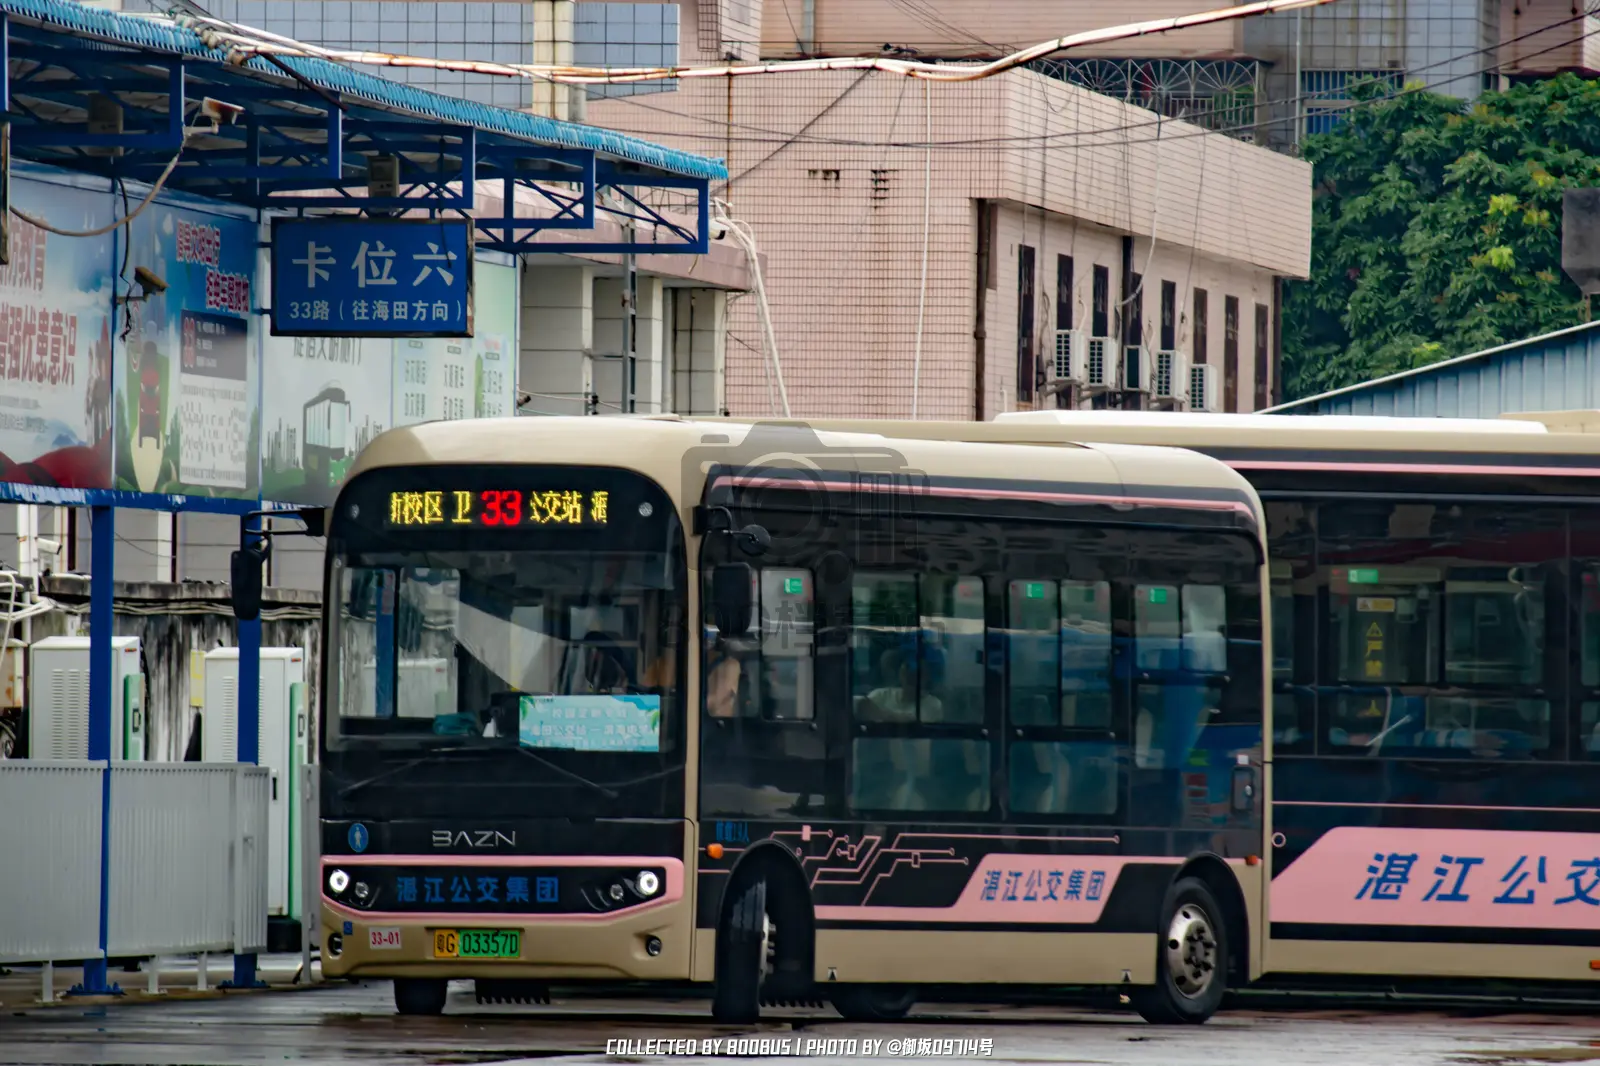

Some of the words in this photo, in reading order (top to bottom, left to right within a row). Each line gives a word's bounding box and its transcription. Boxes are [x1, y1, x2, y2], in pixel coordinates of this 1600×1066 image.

[292, 240, 457, 288] 卡位六
[482, 490, 522, 526] 33
[432, 830, 516, 847] BAZN
[397, 876, 559, 903] 湛江公交集团
[980, 870, 1106, 902] 湛江公交集团
[371, 931, 400, 946] 33-01
